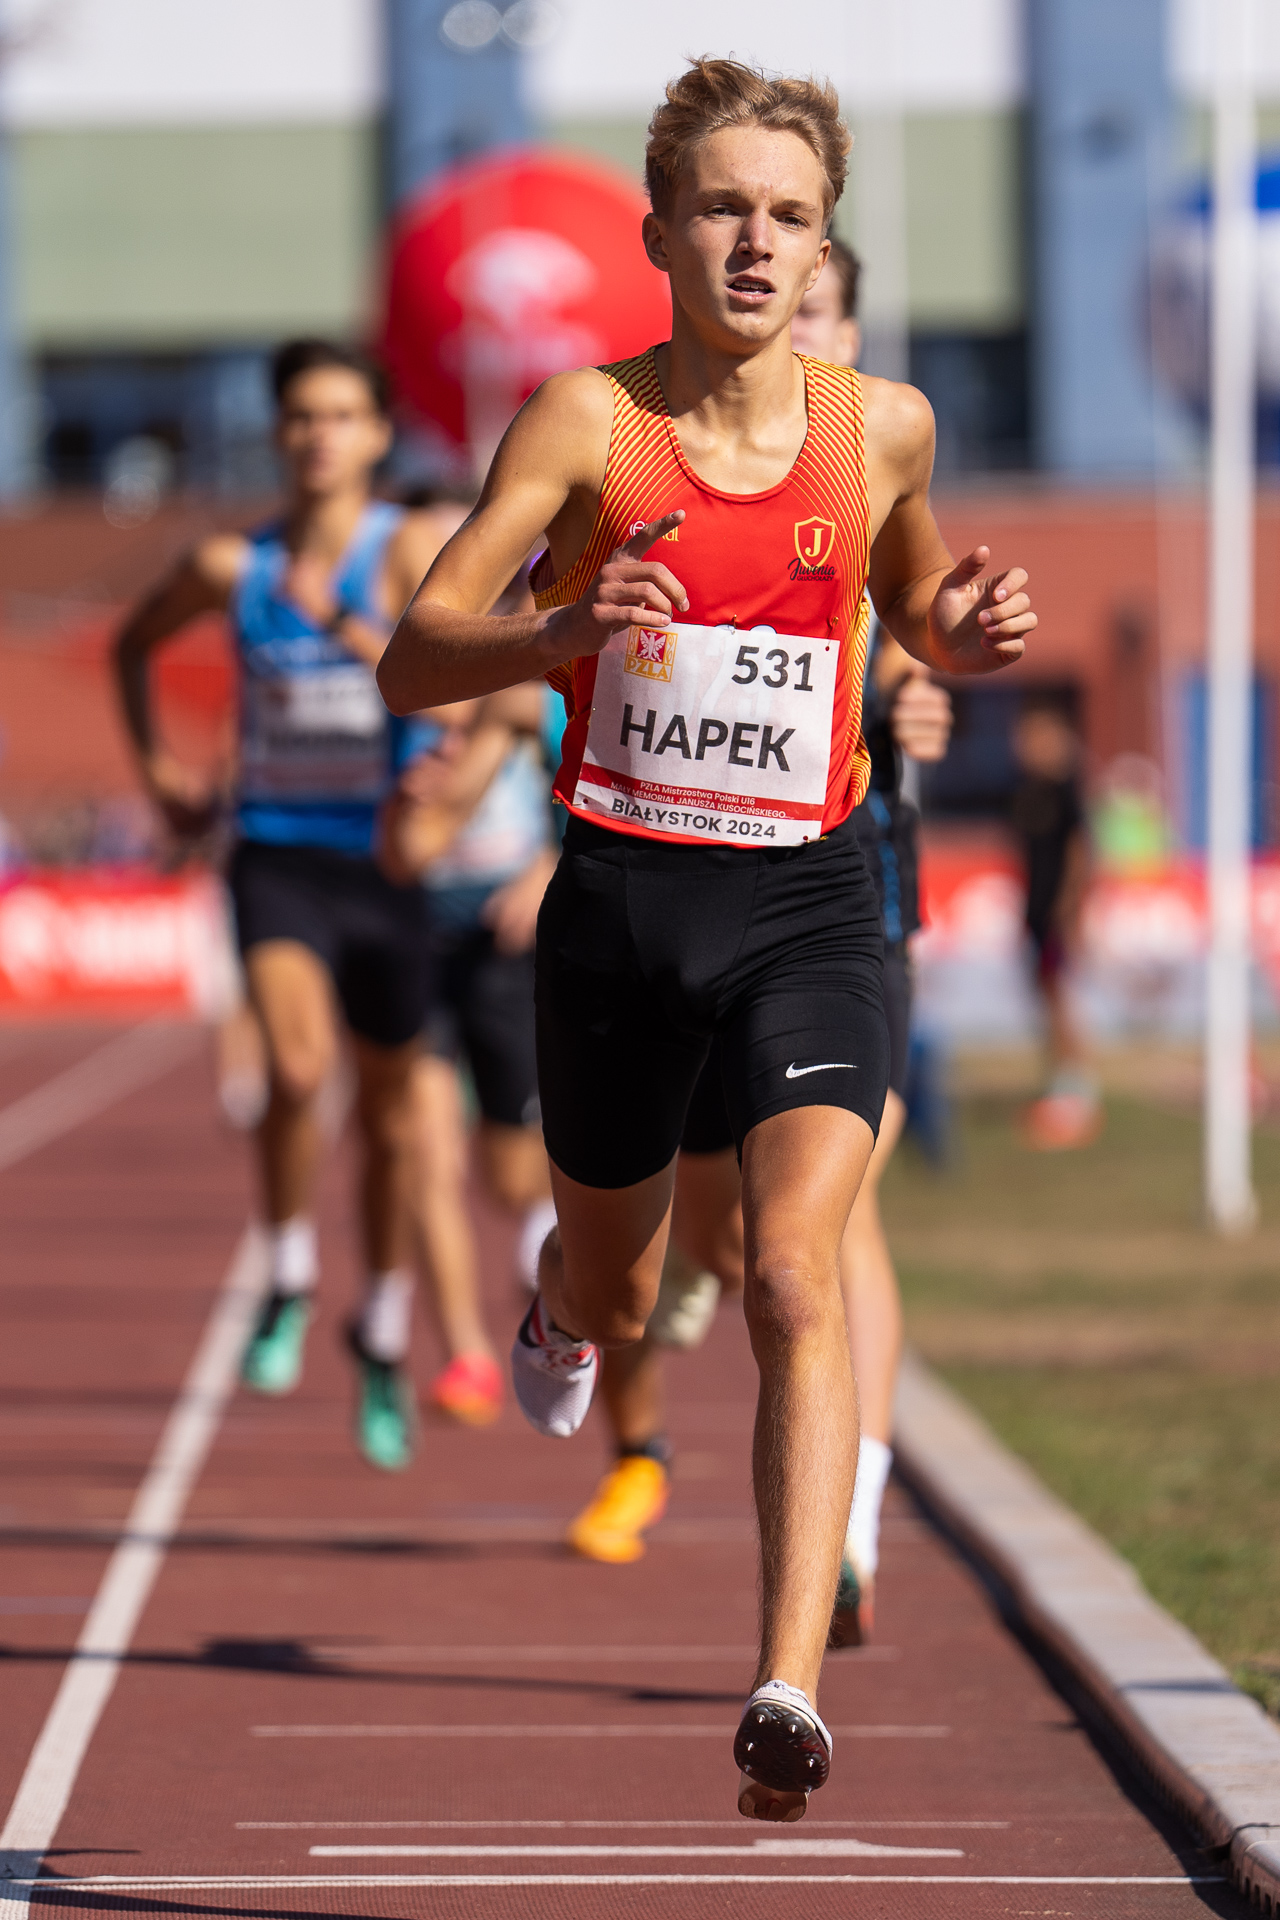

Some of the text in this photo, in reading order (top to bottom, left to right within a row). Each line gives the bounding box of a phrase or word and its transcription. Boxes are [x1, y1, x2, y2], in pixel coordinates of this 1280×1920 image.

[804, 527, 825, 558] J
[787, 557, 838, 581] Juvenia
[626, 656, 669, 680] PZLA
[731, 644, 814, 692] 531
[619, 702, 796, 773] HAPEK
[610, 781, 631, 794] MAŁY
[632, 788, 675, 804] MEMORIAŁ
[676, 796, 716, 809] JANUSZA
[639, 781, 756, 805] PZLA Mistrzostwa Polski U16
[611, 797, 777, 838] BIAŁYSTOK 2024
